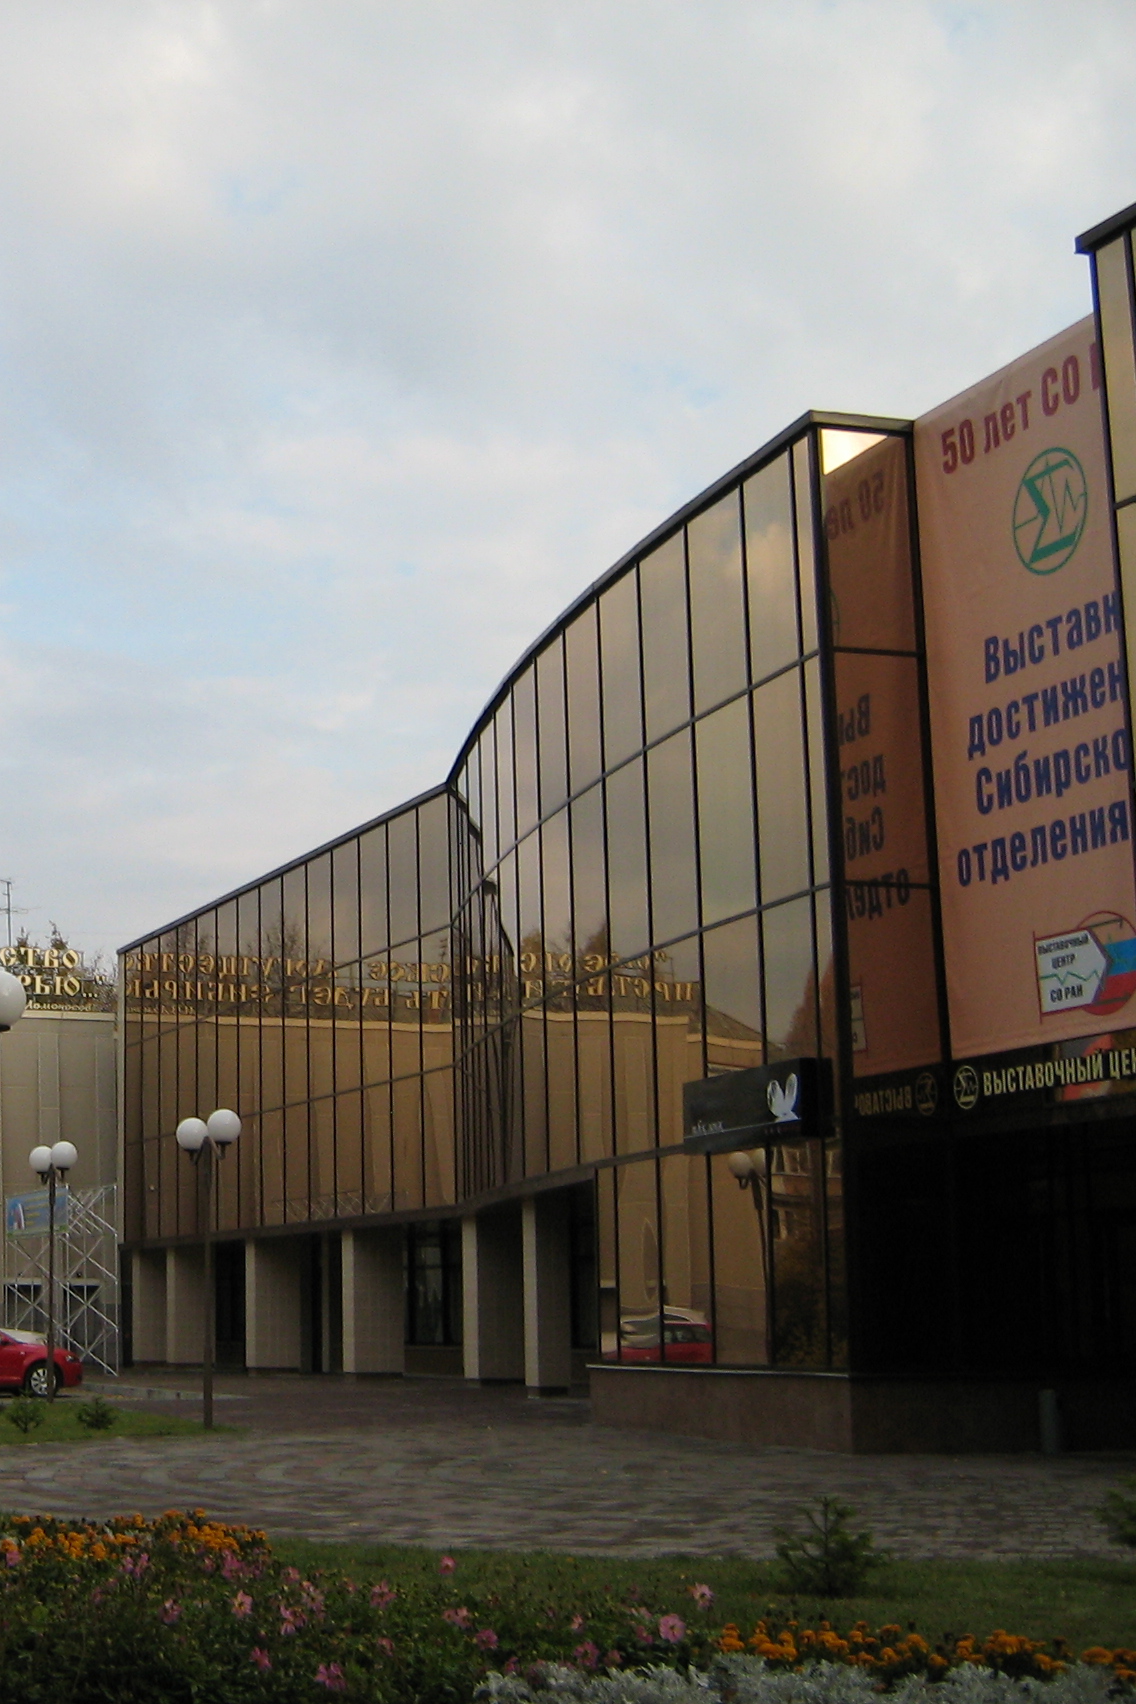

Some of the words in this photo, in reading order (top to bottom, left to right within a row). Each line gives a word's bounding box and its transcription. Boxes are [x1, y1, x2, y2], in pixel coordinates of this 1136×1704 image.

[941, 418, 975, 475] 50
[983, 390, 1032, 455] лет
[1041, 354, 1081, 417] СО
[957, 800, 1130, 887] отделения
[1051, 953, 1076, 970] ЦЕНТР
[1050, 988, 1063, 1003] СО
[1065, 984, 1083, 1000] РАН
[982, 1048, 1104, 1097] ВЫСТАВОЧНЫЙ
